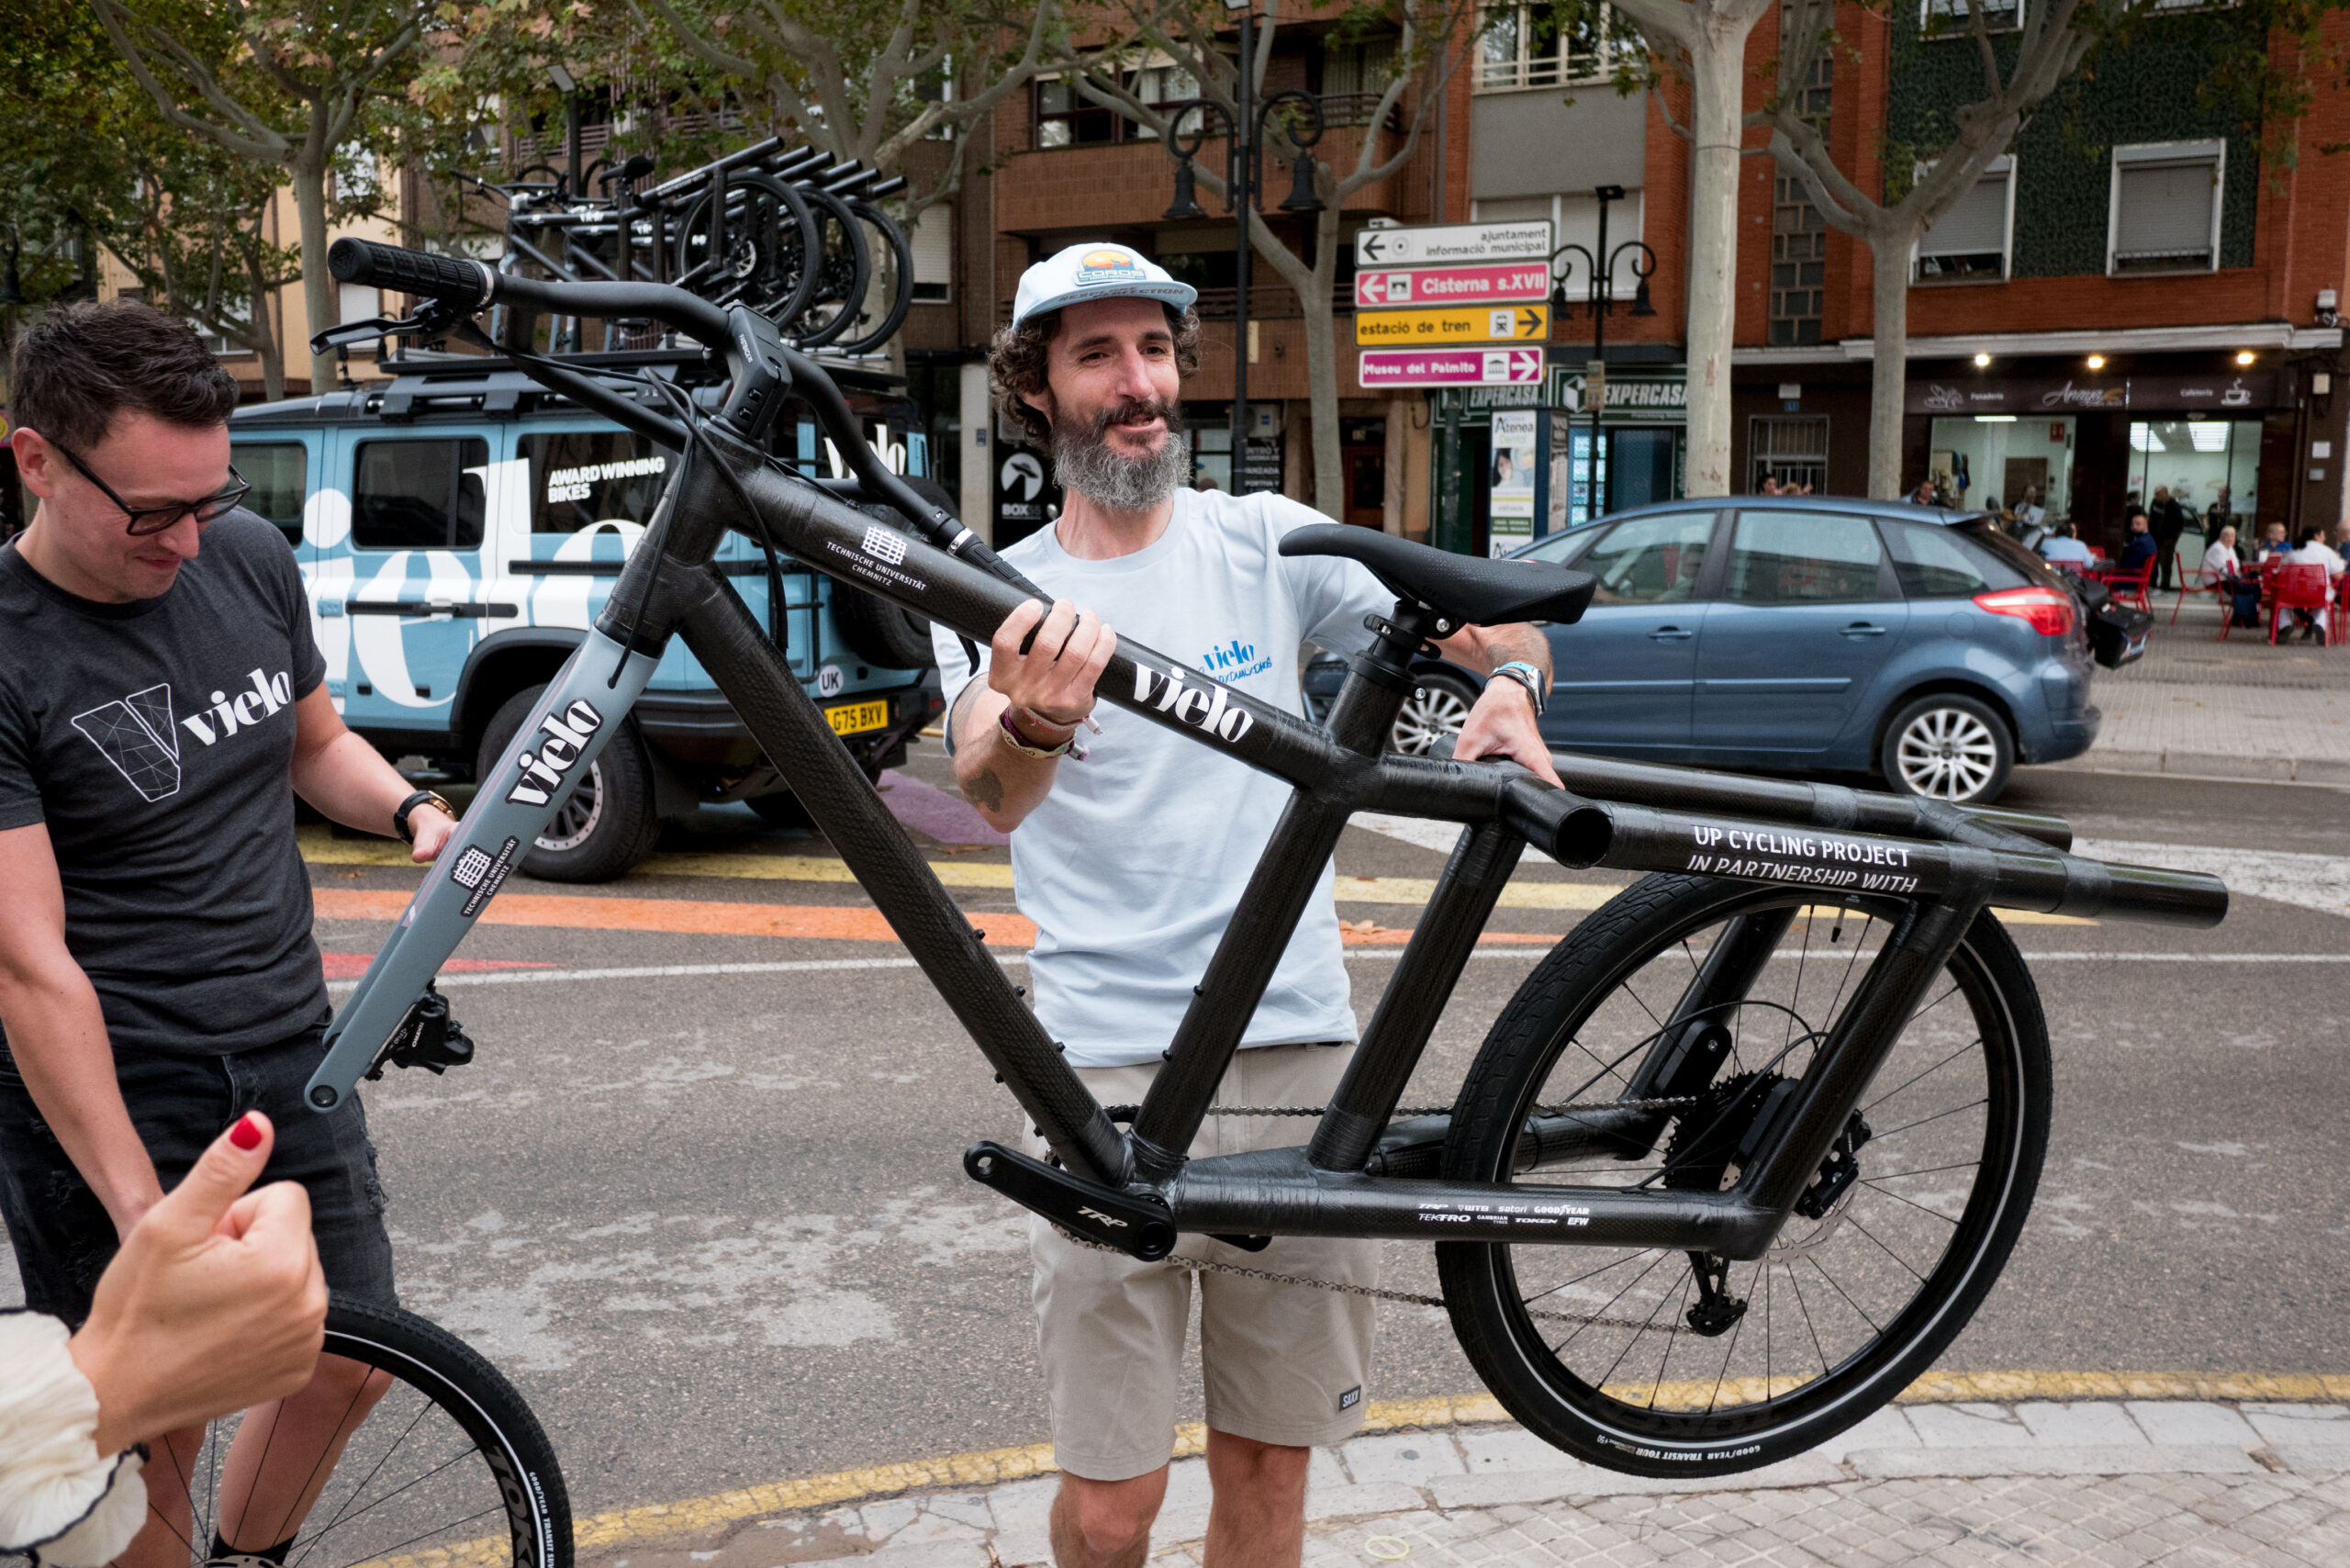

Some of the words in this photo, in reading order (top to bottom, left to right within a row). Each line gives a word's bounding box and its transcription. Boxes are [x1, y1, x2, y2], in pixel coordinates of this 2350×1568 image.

[1481, 229, 1547, 243] ajuntament
[1426, 241, 1486, 256] informació
[1491, 242, 1547, 255] municipal
[1078, 268, 1145, 279] COROS
[1421, 276, 1491, 294] Cisterna
[1497, 273, 1546, 291] s.XVII
[1360, 320, 1411, 335] estació
[1417, 320, 1435, 333] de
[1442, 319, 1472, 332] tren
[1363, 363, 1402, 375] Museu
[1407, 362, 1426, 375] del
[1430, 362, 1477, 375] Palmito
[1470, 386, 1539, 408] EXPERCASA
[1494, 416, 1535, 433] Atenea
[548, 465, 601, 487] AWARD
[600, 456, 666, 481] WINNING
[548, 483, 592, 504] BIKES
[826, 541, 875, 569] TECHNISCHE
[875, 564, 927, 591] UNIVERSITÄT
[852, 565, 892, 587] CHEMNITZ
[1203, 639, 1256, 672] vielo
[822, 671, 840, 690] UK
[179, 667, 292, 746] vielo
[1133, 660, 1255, 744] vielo
[825, 708, 857, 732] G75
[860, 704, 883, 728] BXV
[507, 700, 602, 805] vielo
[1692, 825, 1723, 847] UP
[1728, 829, 1817, 857] CYCLING
[1820, 839, 1910, 868] PROJECT
[464, 879, 492, 915] TECHNISCHE
[487, 837, 517, 882] UNIVERSITÄT
[486, 865, 510, 896] CHEMNITZ
[1686, 855, 1713, 872] IN
[1713, 857, 1858, 887] PARTNERSHIP
[1861, 872, 1919, 893] WITH
[1076, 1205, 1129, 1227] TRP
[1418, 1213, 1472, 1223] TEKTRO
[1566, 1216, 1590, 1226] EFW
[1497, 1204, 1528, 1214] satori
[1533, 1204, 1591, 1215] GOODYEAR
[1634, 1447, 1662, 1461] TOUR
[1661, 1451, 1703, 1462] TRANSIT
[487, 1445, 534, 1568] TOK
[543, 1517, 554, 1551] TRANSIT
